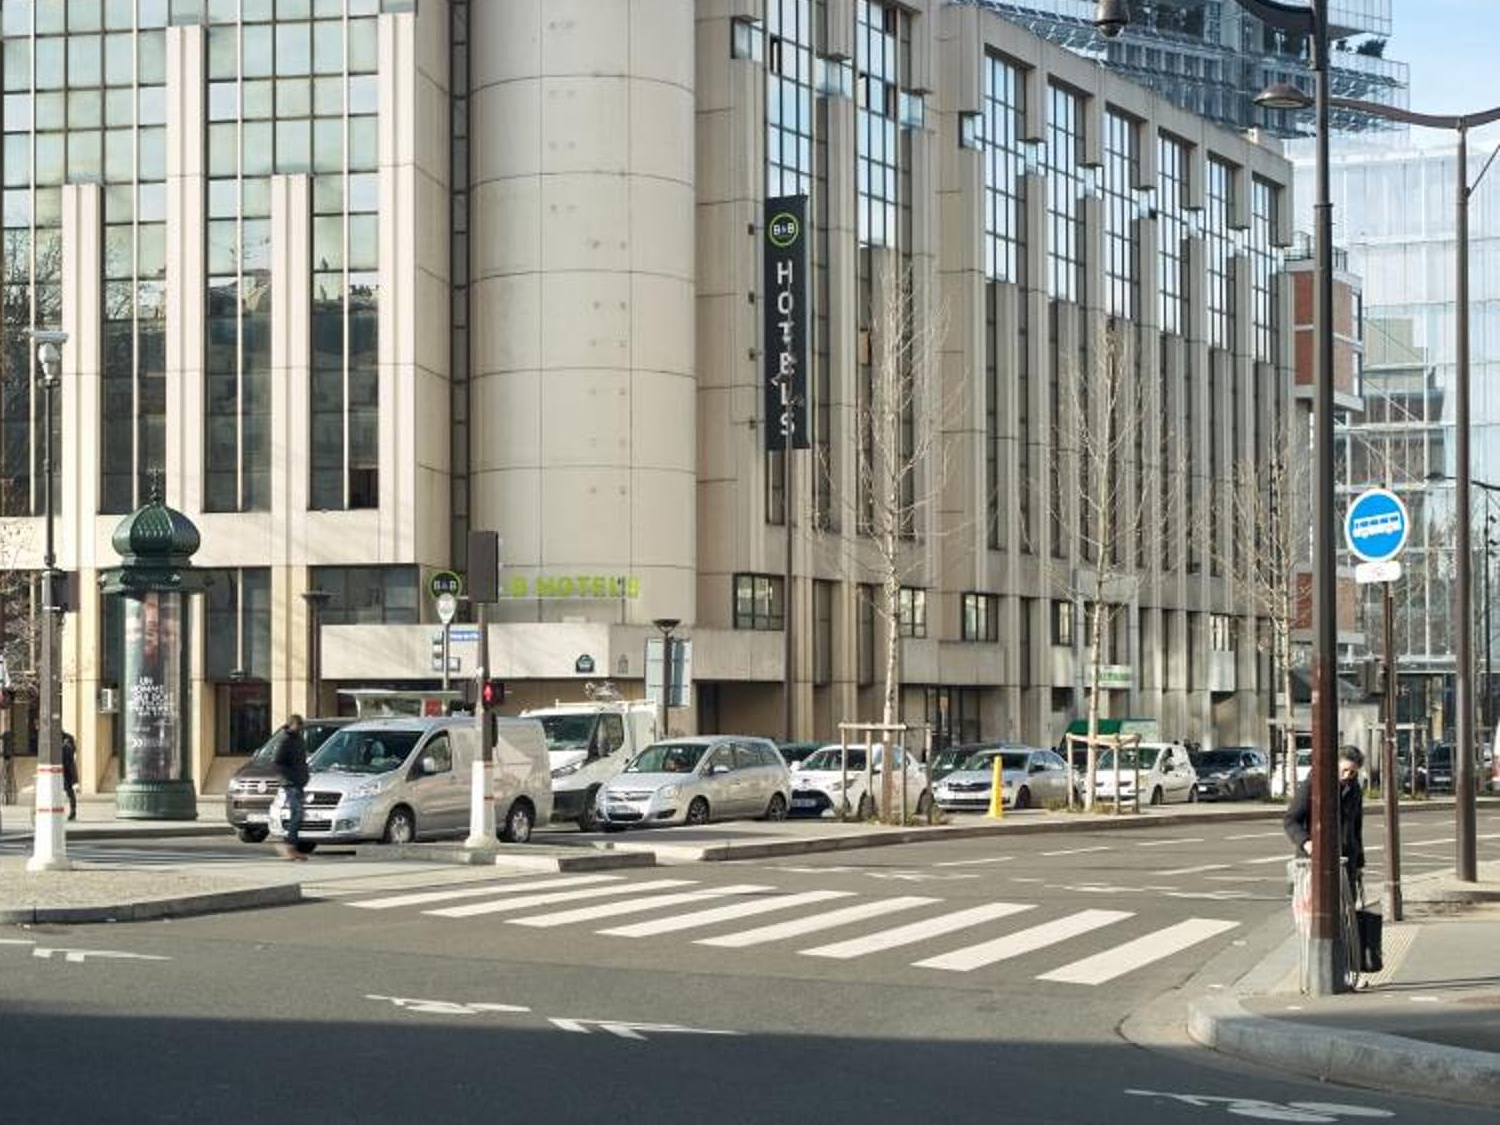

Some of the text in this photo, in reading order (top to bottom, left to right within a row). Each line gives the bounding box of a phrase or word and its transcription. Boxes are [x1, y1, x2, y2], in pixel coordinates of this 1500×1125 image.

[773, 222, 795, 236] B&B
[776, 260, 796, 436] HOTELS
[536, 575, 639, 597] HOTELS
